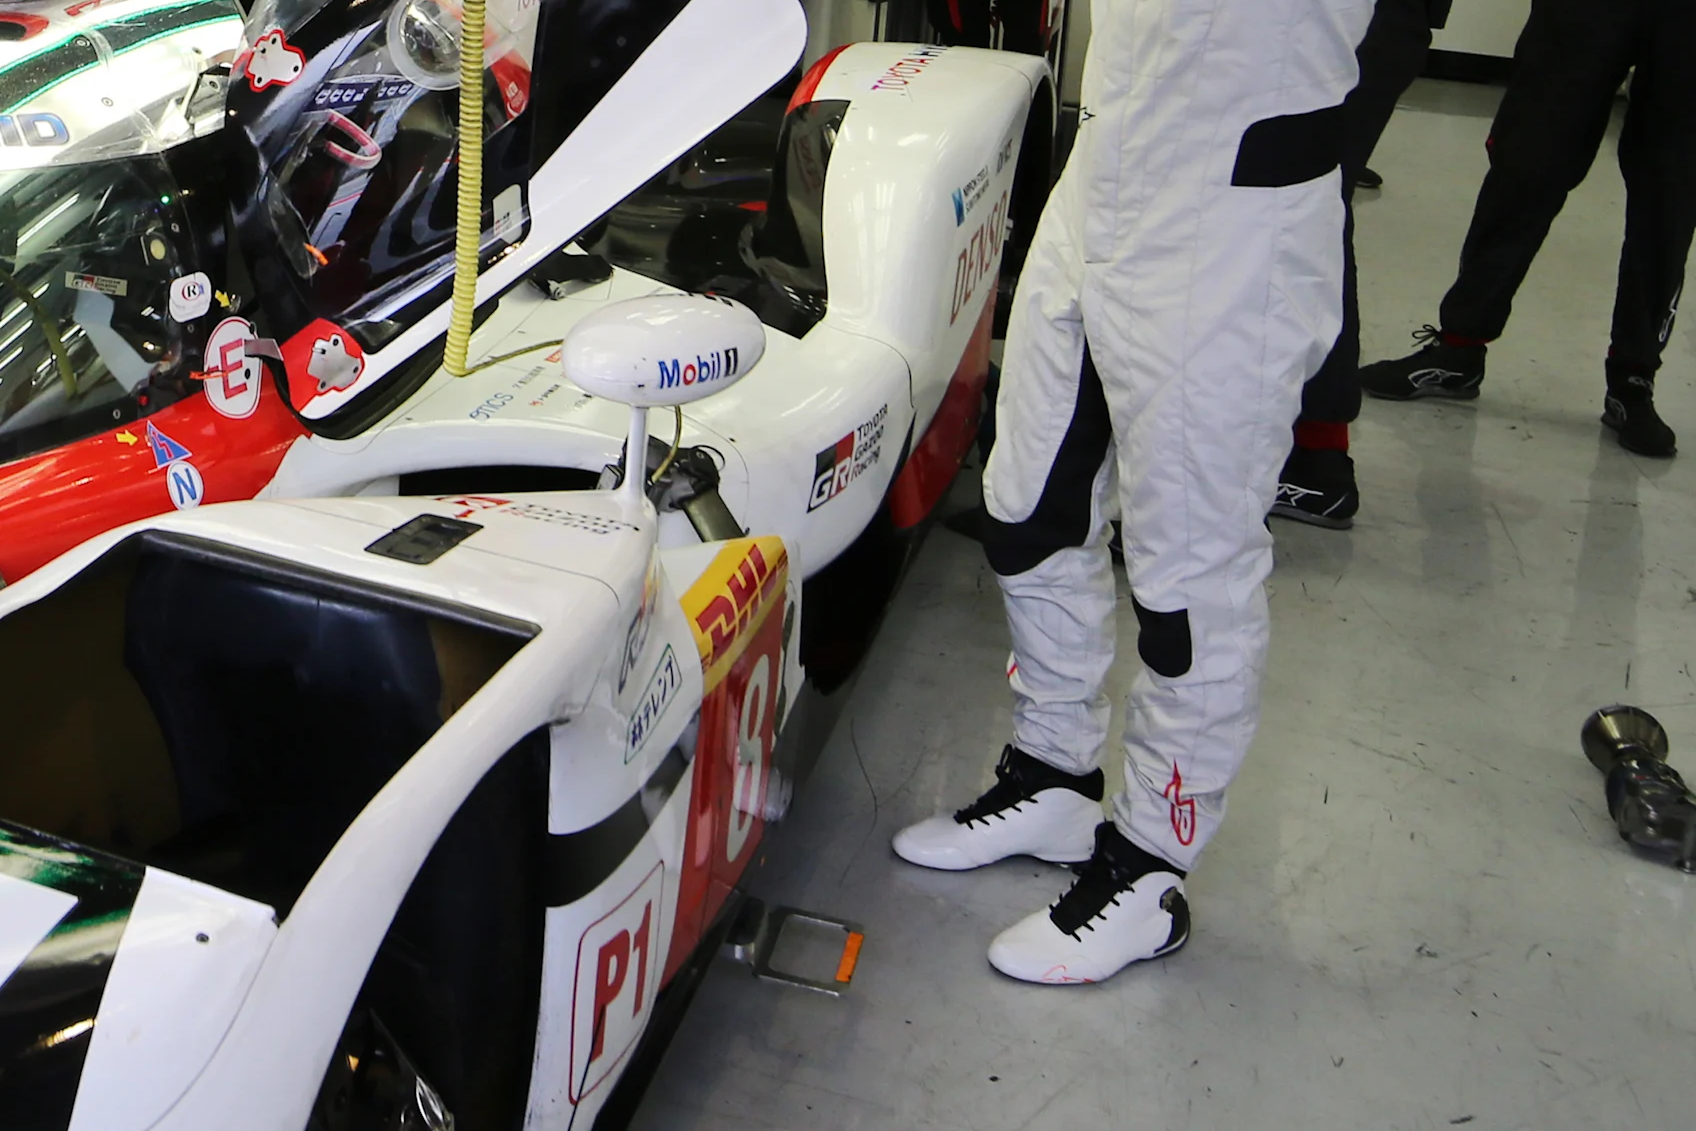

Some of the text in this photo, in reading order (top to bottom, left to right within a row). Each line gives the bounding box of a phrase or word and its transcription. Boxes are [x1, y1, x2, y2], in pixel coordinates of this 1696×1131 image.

[871, 58, 934, 90] TOYOTA
[949, 190, 1008, 328] DENSO
[219, 337, 248, 401] E
[658, 347, 739, 390] Mobil 1
[172, 467, 197, 505] N
[809, 456, 852, 509] GR
[695, 543, 777, 663] DHL
[725, 653, 770, 862] 8
[590, 899, 652, 1064] P1
